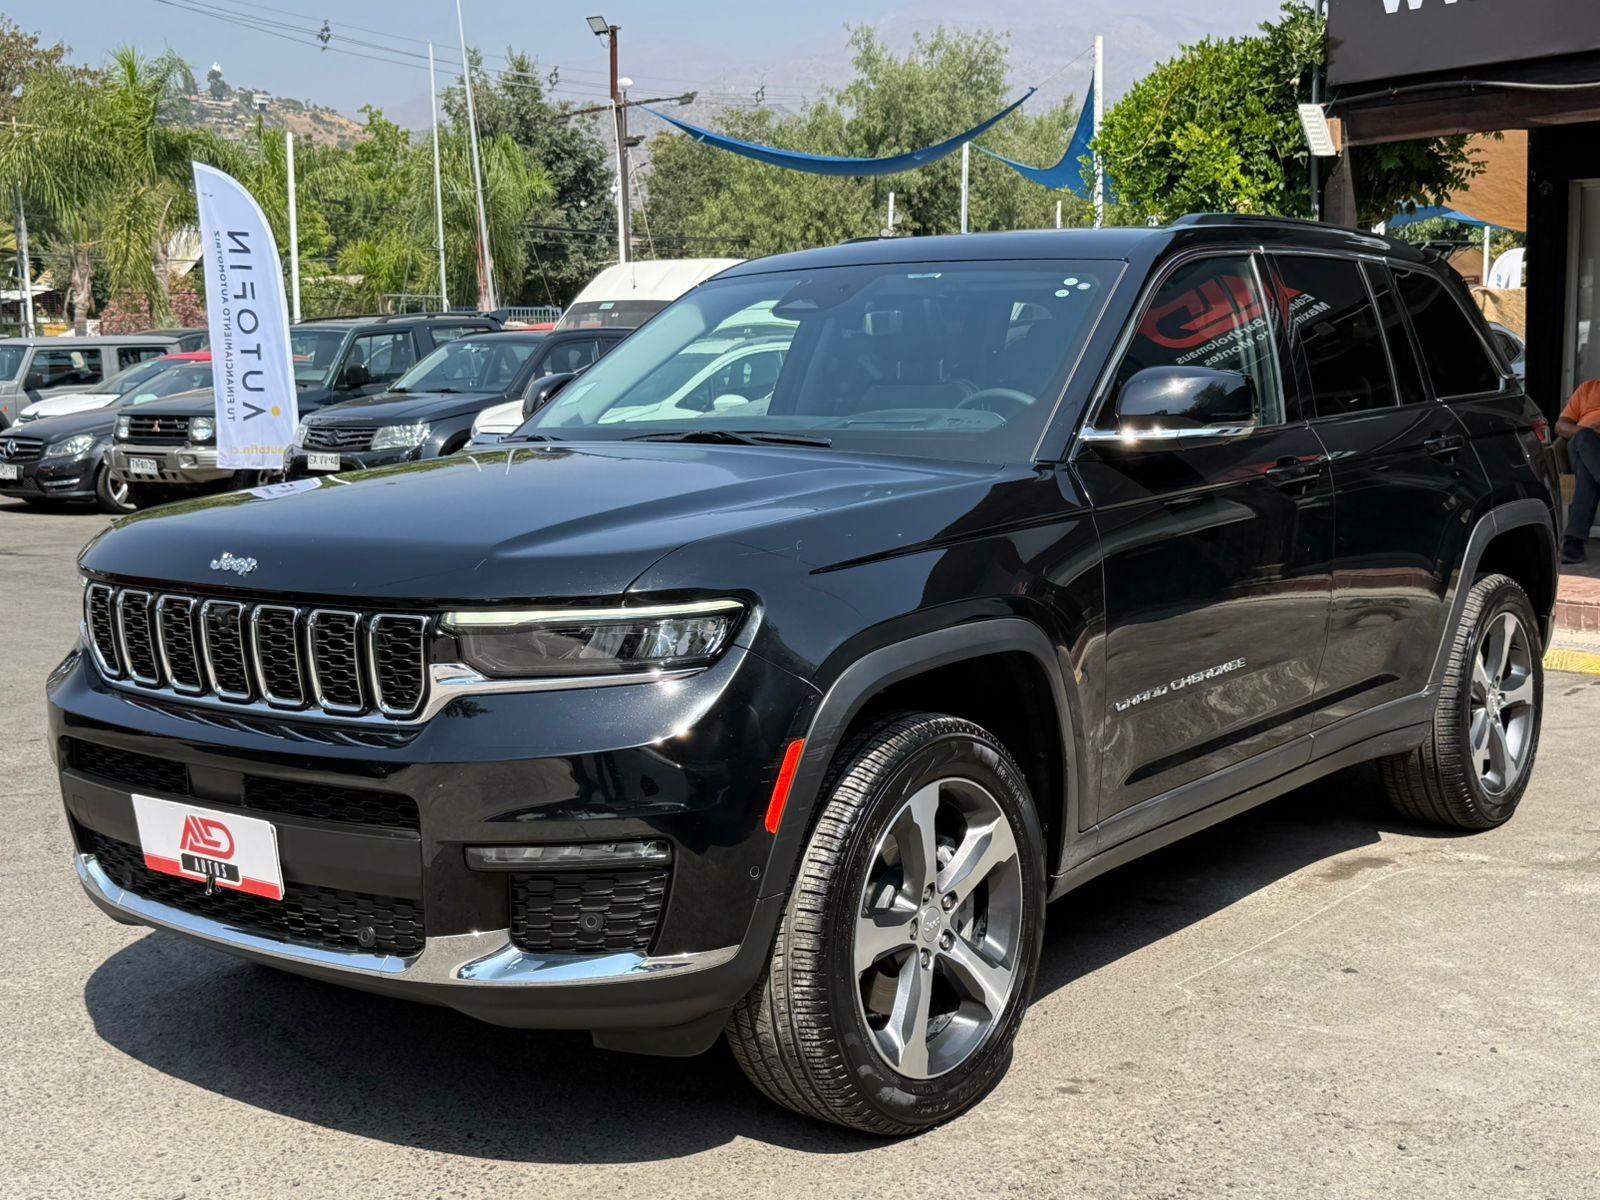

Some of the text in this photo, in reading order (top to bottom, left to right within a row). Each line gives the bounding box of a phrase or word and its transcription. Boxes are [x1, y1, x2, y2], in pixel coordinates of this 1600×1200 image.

[210, 552, 258, 577] Jeep
[1114, 657, 1247, 712] GRAND CHEROKEE
[194, 857, 228, 878] AUTOS
